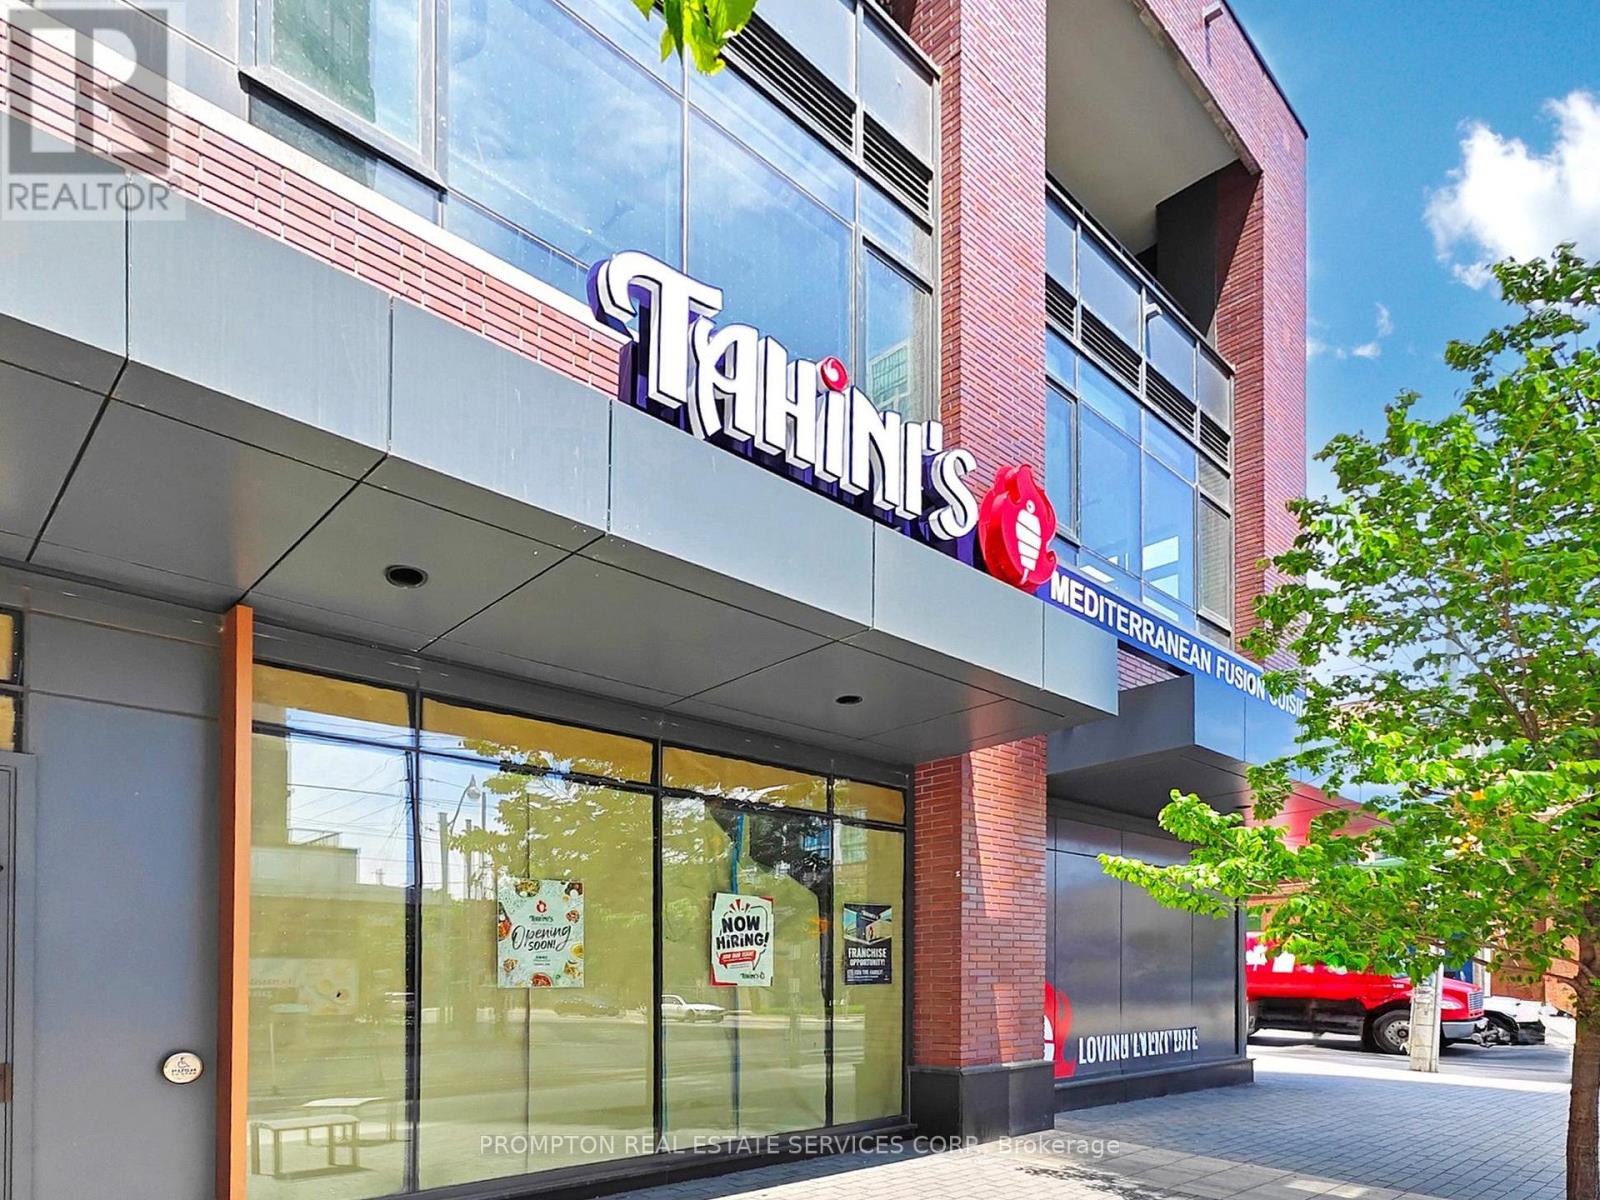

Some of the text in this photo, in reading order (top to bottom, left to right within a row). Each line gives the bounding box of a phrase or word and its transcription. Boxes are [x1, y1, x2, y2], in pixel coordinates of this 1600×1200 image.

[1050, 571, 1212, 675] MEDITERRANEAN
[1215, 655, 1266, 701] FUSION
[721, 915, 761, 934] NOW
[511, 925, 572, 952] Opening
[528, 940, 557, 952] SOON!
[848, 948, 887, 958] FRANCHISE
[1078, 1033, 1129, 1065] LOVING
